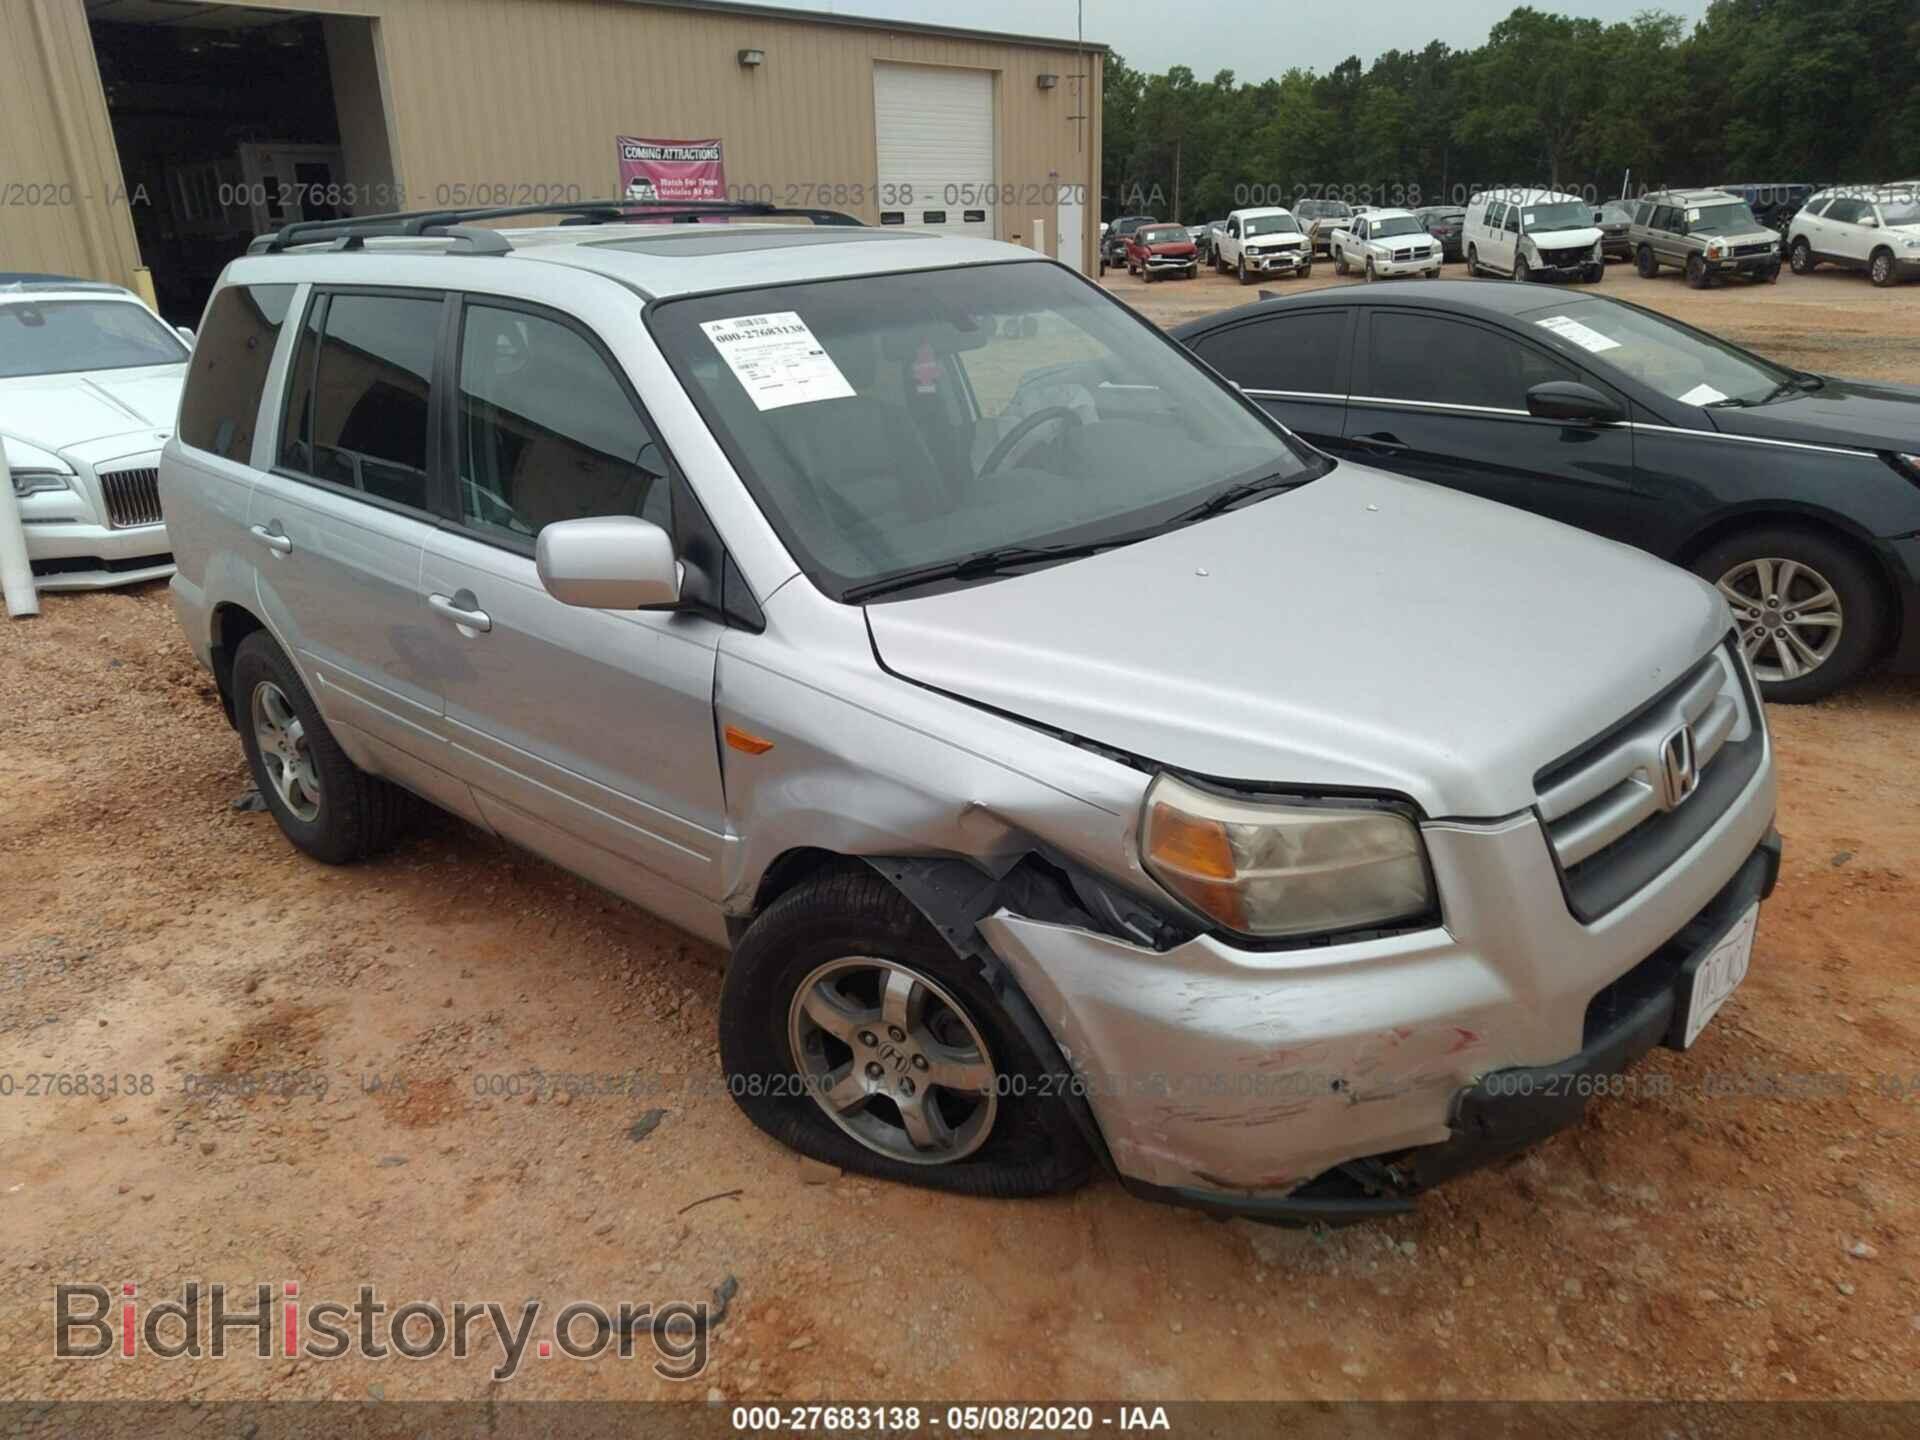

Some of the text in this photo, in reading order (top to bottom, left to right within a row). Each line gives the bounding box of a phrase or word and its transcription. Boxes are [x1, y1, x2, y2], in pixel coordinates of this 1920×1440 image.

[625, 146, 719, 160] COMING ATTRACTIONS
[715, 324, 806, 344] 000-27683138
